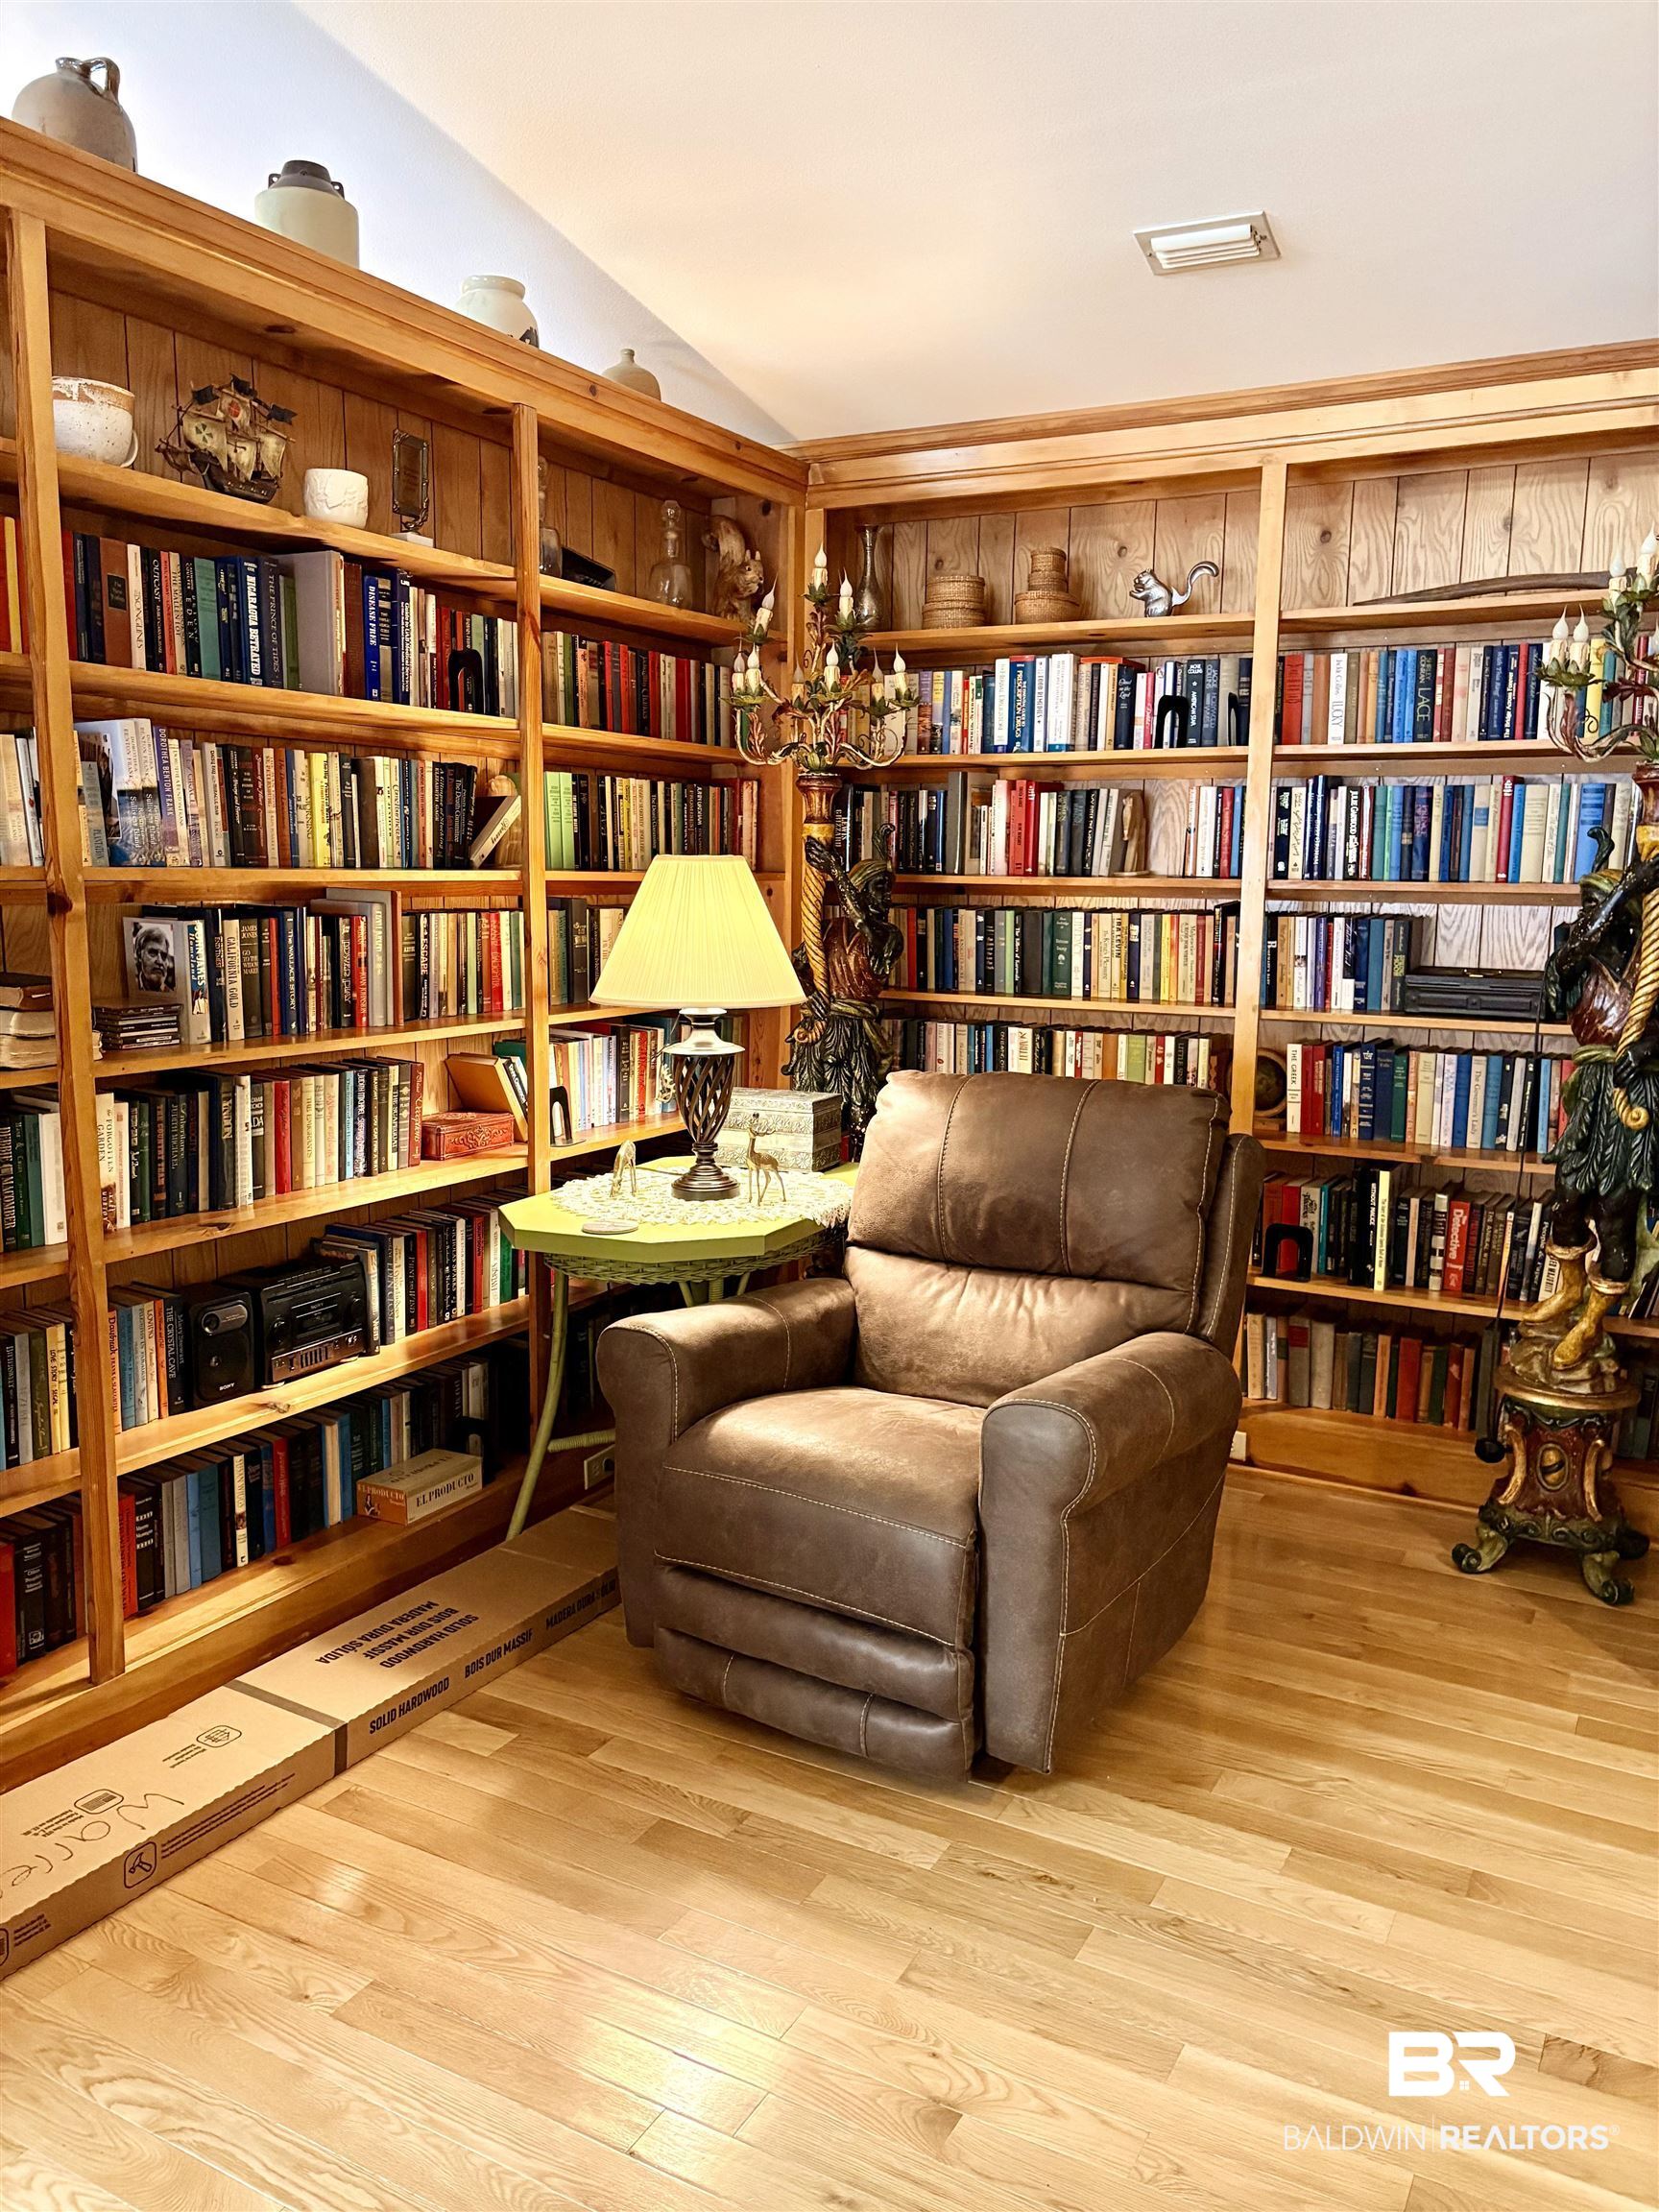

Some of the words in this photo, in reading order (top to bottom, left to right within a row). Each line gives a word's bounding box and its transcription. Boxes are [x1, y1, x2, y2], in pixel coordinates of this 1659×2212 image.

[153, 559, 161, 602] OUTCAST
[247, 574, 259, 626] NICARAGUA
[269, 594, 277, 630] PRINCE
[185, 597, 196, 638] EDEN
[272, 632, 278, 646] OF
[369, 622, 377, 646] FREE
[249, 628, 261, 676] BETRAYED
[272, 647, 280, 673] TIDES
[1416, 687, 1431, 722] LACE
[158, 728, 169, 765] DOROTHEA
[161, 765, 171, 792] BENTON
[164, 794, 174, 816] FRANK
[439, 806, 445, 815] of
[93, 828, 104, 860] PLANTATION
[196, 956, 206, 986] JAKES
[227, 936, 238, 985] CALIFORNIA
[229, 987, 239, 1008] GOLD
[179, 1102, 187, 1159] Inheritance
[411, 1094, 422, 1142] Deceptions
[1470, 1119, 1479, 1135] Lady
[0, 1126, 12, 1162] DEBBIE
[97, 1124, 106, 1162] GARDEN
[106, 1118, 114, 1173] FORGOTTEN
[1, 1176, 15, 1230] MACOMBER
[1449, 1208, 1464, 1260] Detective
[1539, 1221, 1549, 1249] People
[1533, 1262, 1543, 1286] Paper
[108, 1316, 117, 1356] Daybreak
[219, 1382, 235, 1391] SONY
[235, 1457, 244, 1483] SUSAN
[367, 1485, 405, 1501] PRODUCTO
[416, 1494, 428, 1507] EL
[428, 1473, 474, 1502] PRODUCTO
[394, 1600, 439, 1627] MADERA
[406, 1619, 433, 1636] DUR
[431, 1607, 459, 1624] BOIS
[444, 1614, 479, 1635] SOLID
[360, 1621, 397, 1644] DURA
[363, 1631, 407, 1660] MASSIF
[315, 1638, 363, 1665] SÓLIDA
[370, 1708, 397, 1735] SOLID
[398, 1676, 449, 1719] HARDWOOD
[465, 1658, 485, 1679] BOIS
[486, 1647, 503, 1668] DUR
[503, 1628, 534, 1656] MASSIF
[545, 1603, 576, 1630] MADERA
[576, 1592, 595, 1611] DURA
[379, 1629, 449, 1669] HARDWOOD
